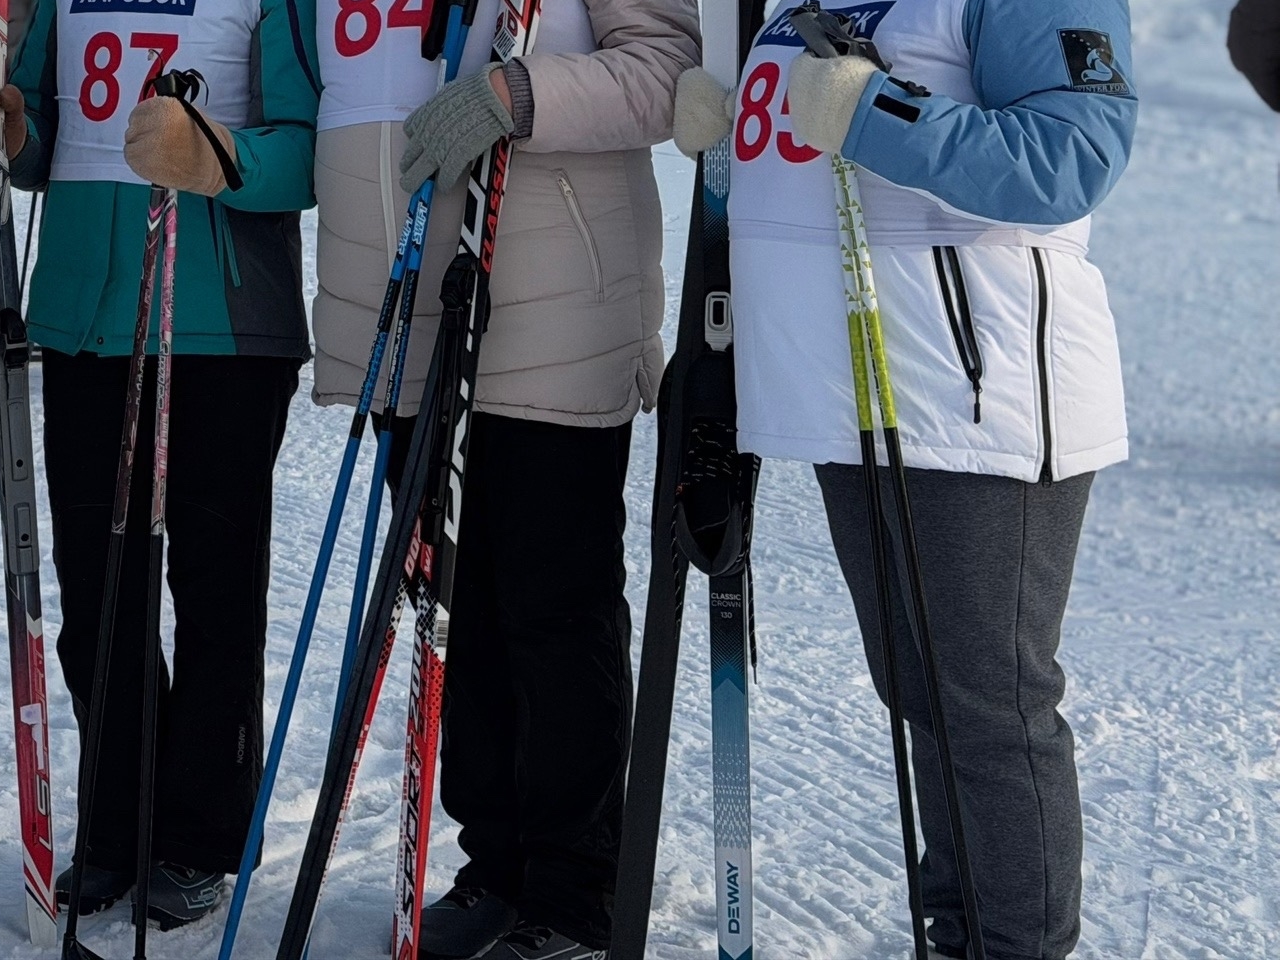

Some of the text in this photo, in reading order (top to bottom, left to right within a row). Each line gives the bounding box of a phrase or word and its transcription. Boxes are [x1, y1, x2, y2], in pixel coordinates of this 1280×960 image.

[78, 31, 179, 122] 87
[710, 592, 742, 601] CLASSIC
[710, 600, 742, 608] CROWN
[720, 611, 733, 619] 130
[400, 733, 422, 930] SPORT
[726, 860, 740, 934] DEWAY
